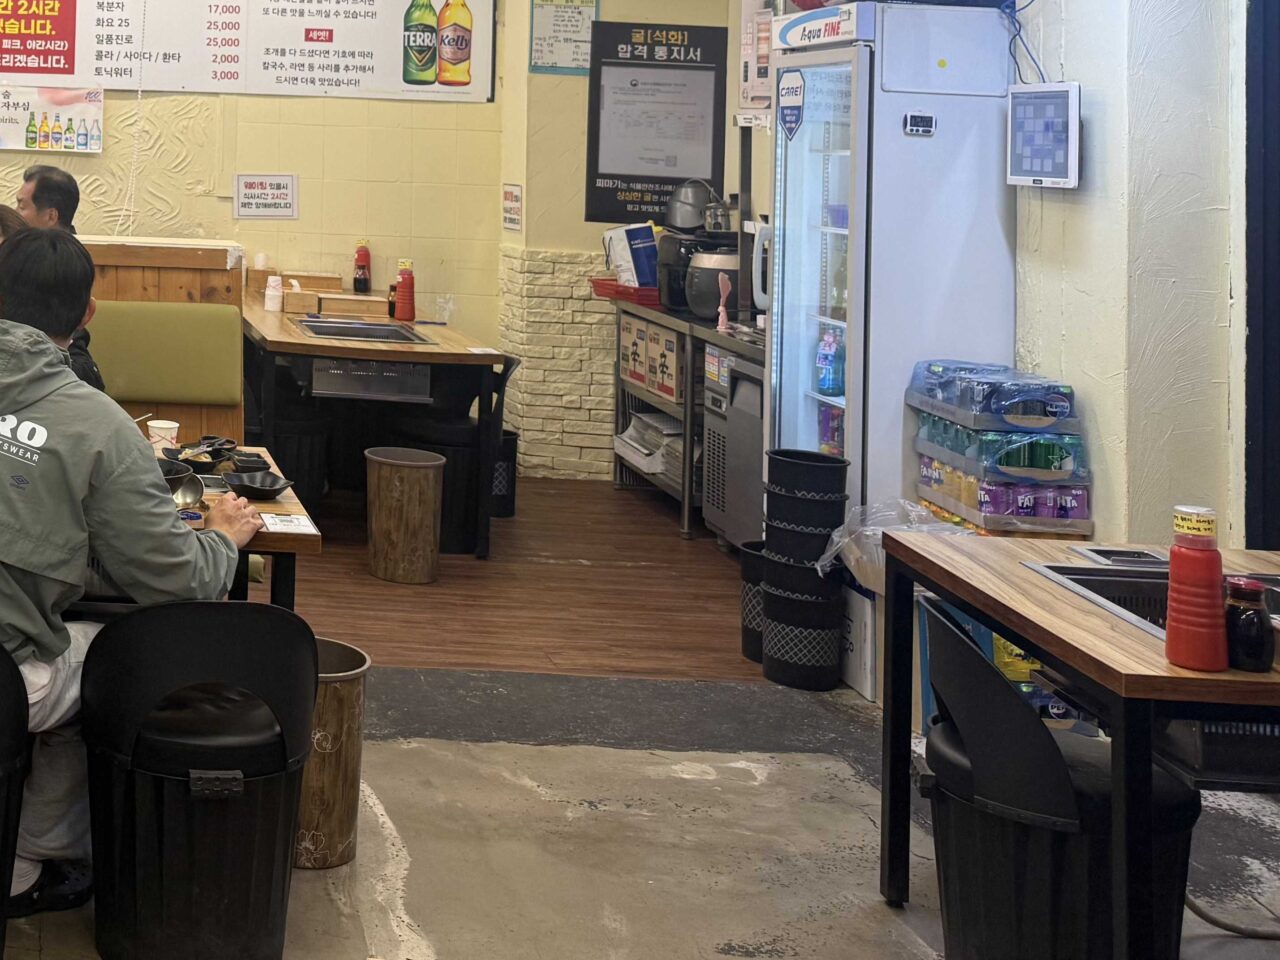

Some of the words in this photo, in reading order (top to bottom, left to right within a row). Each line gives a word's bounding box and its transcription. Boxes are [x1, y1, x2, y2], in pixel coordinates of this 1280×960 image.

[18, 0, 60, 15] 2시간
[96, 2, 124, 12] 복분자
[208, 5, 240, 15] 17,000
[96, 18, 114, 28] 화요
[118, 19, 129, 27] 25
[207, 22, 240, 31] 25,000
[631, 29, 688, 44] 굴[석화]
[801, 27, 820, 42] Aqua
[823, 21, 840, 37] FINE
[95, 34, 133, 45] 일품진로
[403, 32, 436, 47] TERRA
[440, 35, 469, 49] Kelly
[95, 50, 113, 61] 콜라
[618, 44, 647, 58] 합격
[655, 46, 701, 61] 통지서
[94, 67, 132, 78] 토닉워터
[2, 90, 11, 99] 술
[1, 102, 30, 111] 자부심
